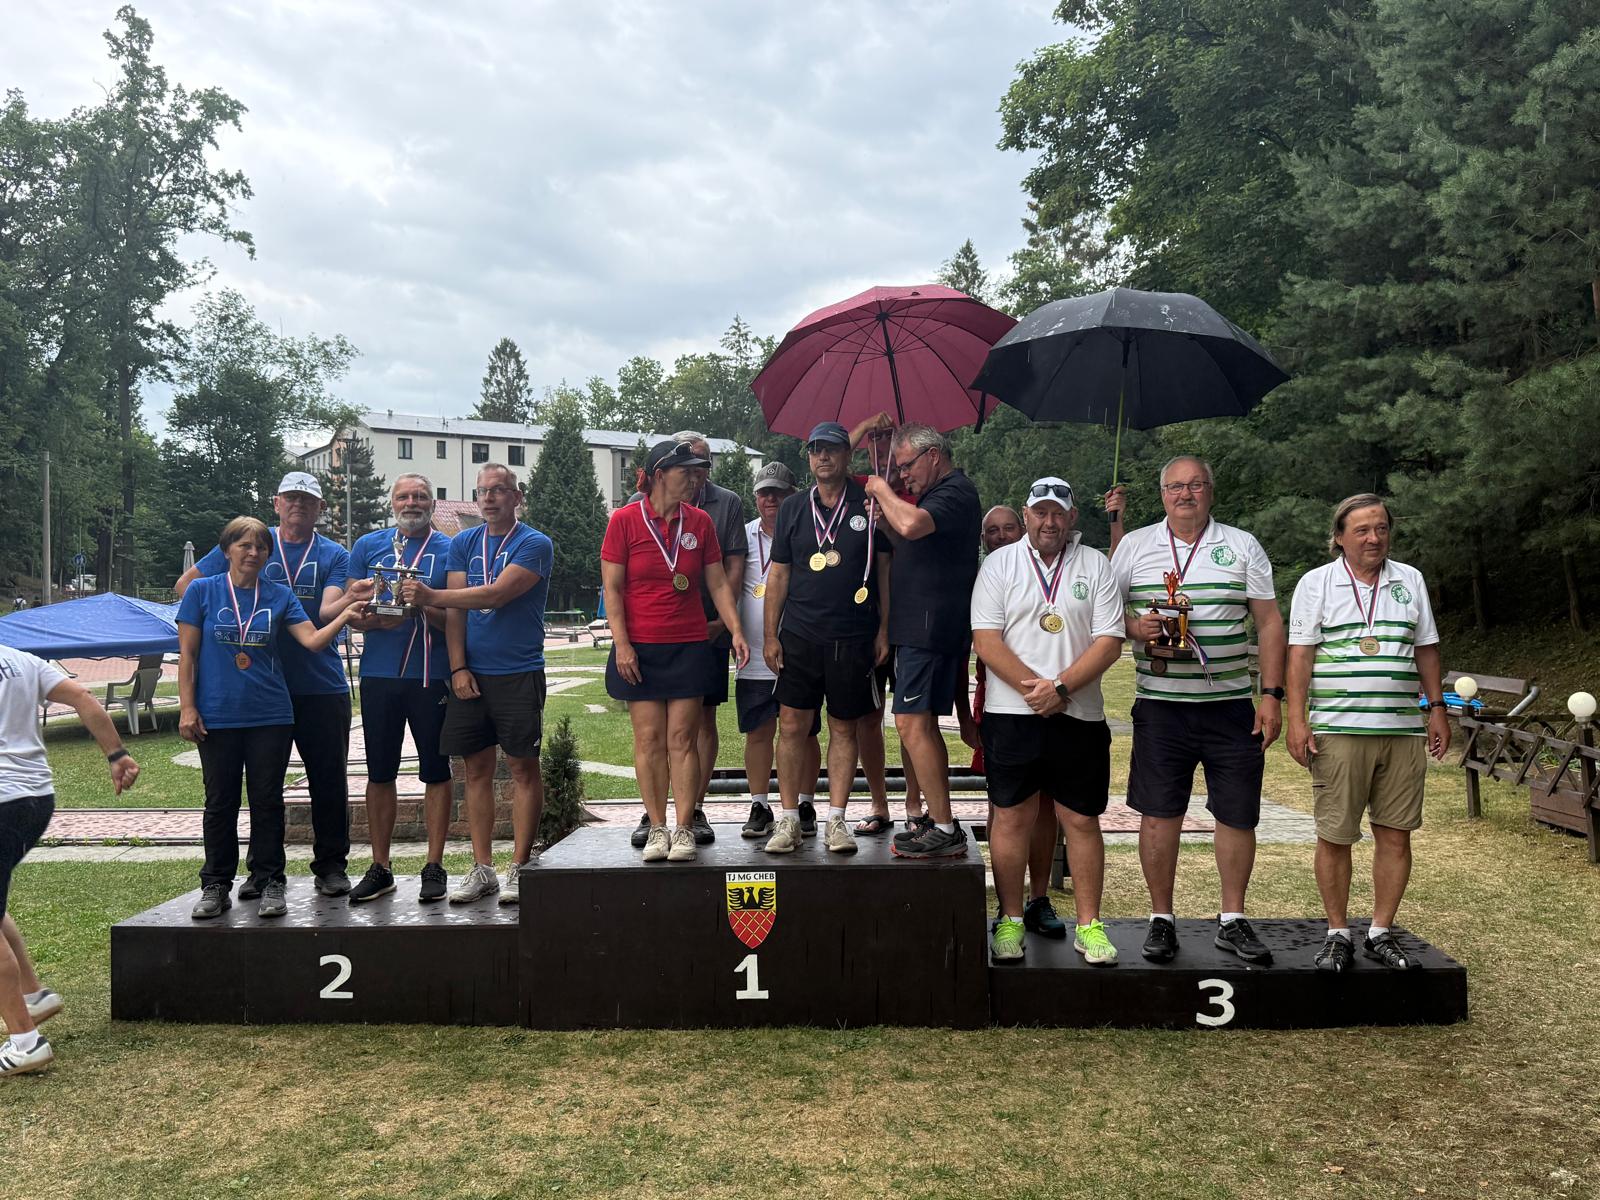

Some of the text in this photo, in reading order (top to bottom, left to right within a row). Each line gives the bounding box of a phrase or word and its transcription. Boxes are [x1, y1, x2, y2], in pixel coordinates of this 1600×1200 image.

[727, 872, 775, 882] TJ MG CHEB
[319, 954, 354, 999] 2
[734, 954, 769, 1000] 1
[1195, 978, 1235, 1027] 3
